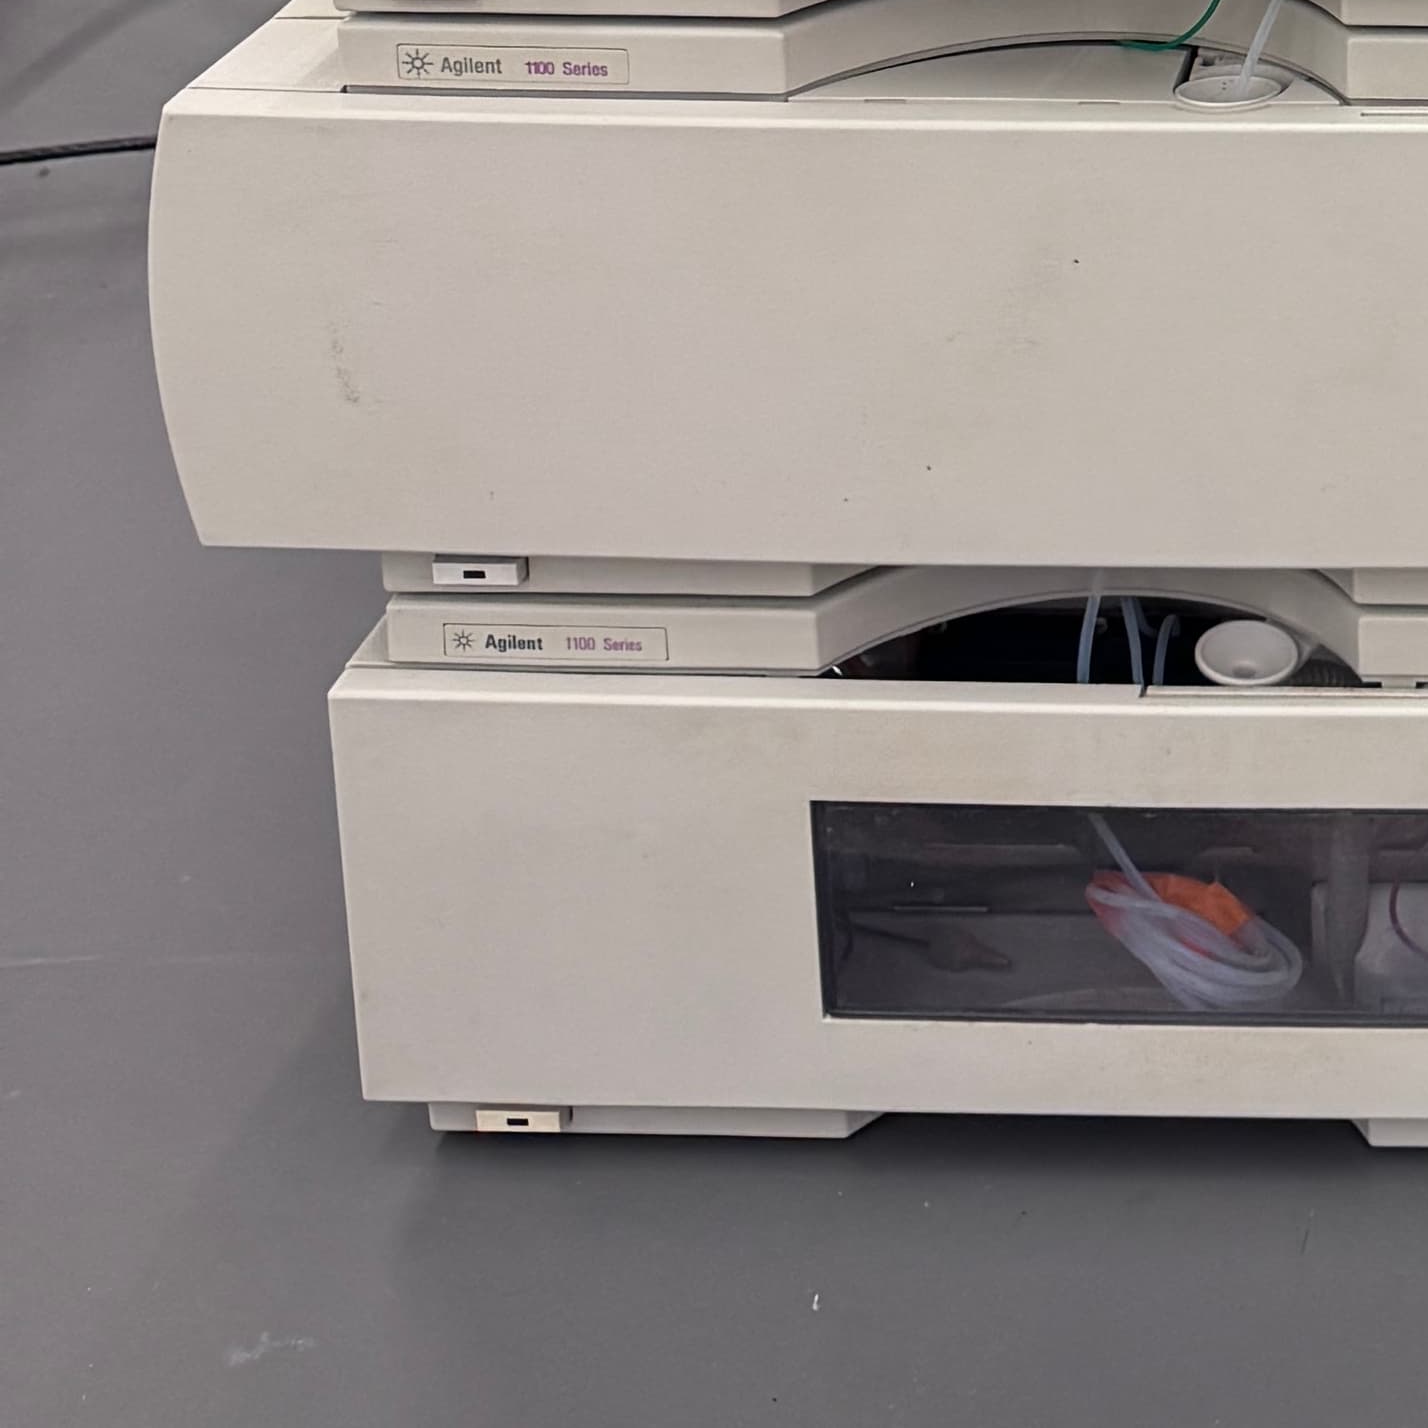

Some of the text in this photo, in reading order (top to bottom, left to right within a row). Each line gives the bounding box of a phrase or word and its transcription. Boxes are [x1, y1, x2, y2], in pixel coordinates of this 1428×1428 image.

[440, 56, 608, 77] Agilent 1100 Series
[484, 633, 642, 653] Agilent 1100 Series
